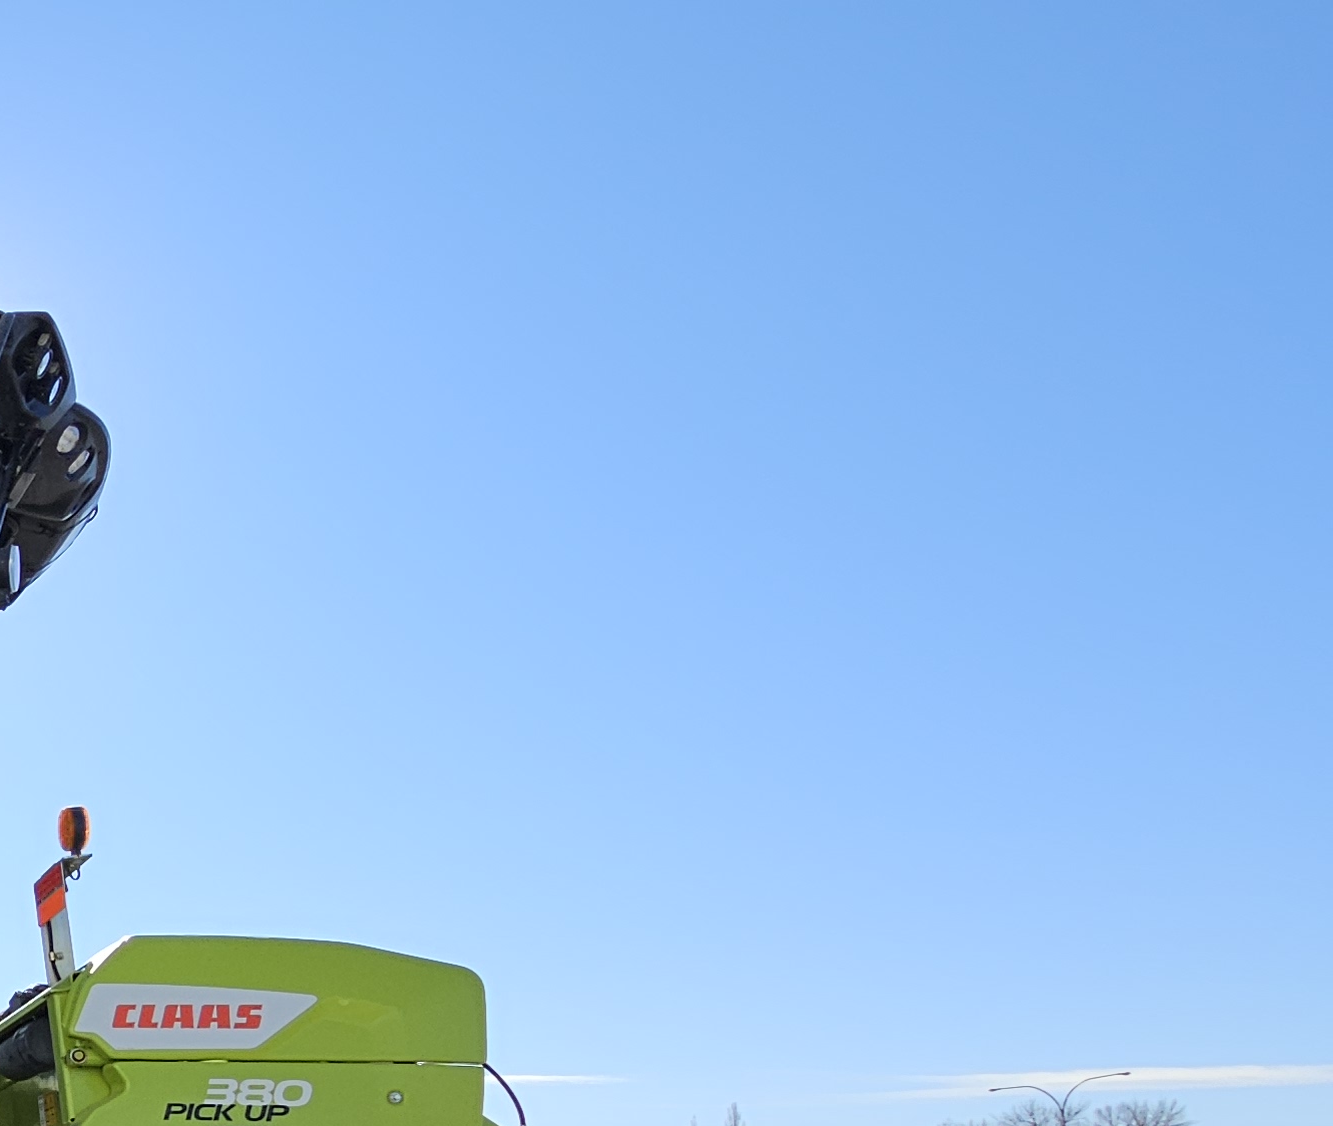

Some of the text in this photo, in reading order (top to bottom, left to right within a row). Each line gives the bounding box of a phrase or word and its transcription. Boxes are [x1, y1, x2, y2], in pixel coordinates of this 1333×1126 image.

[112, 1004, 262, 1029] CLAAS
[204, 1078, 313, 1107] 380
[163, 1103, 290, 1122] PICK UP
